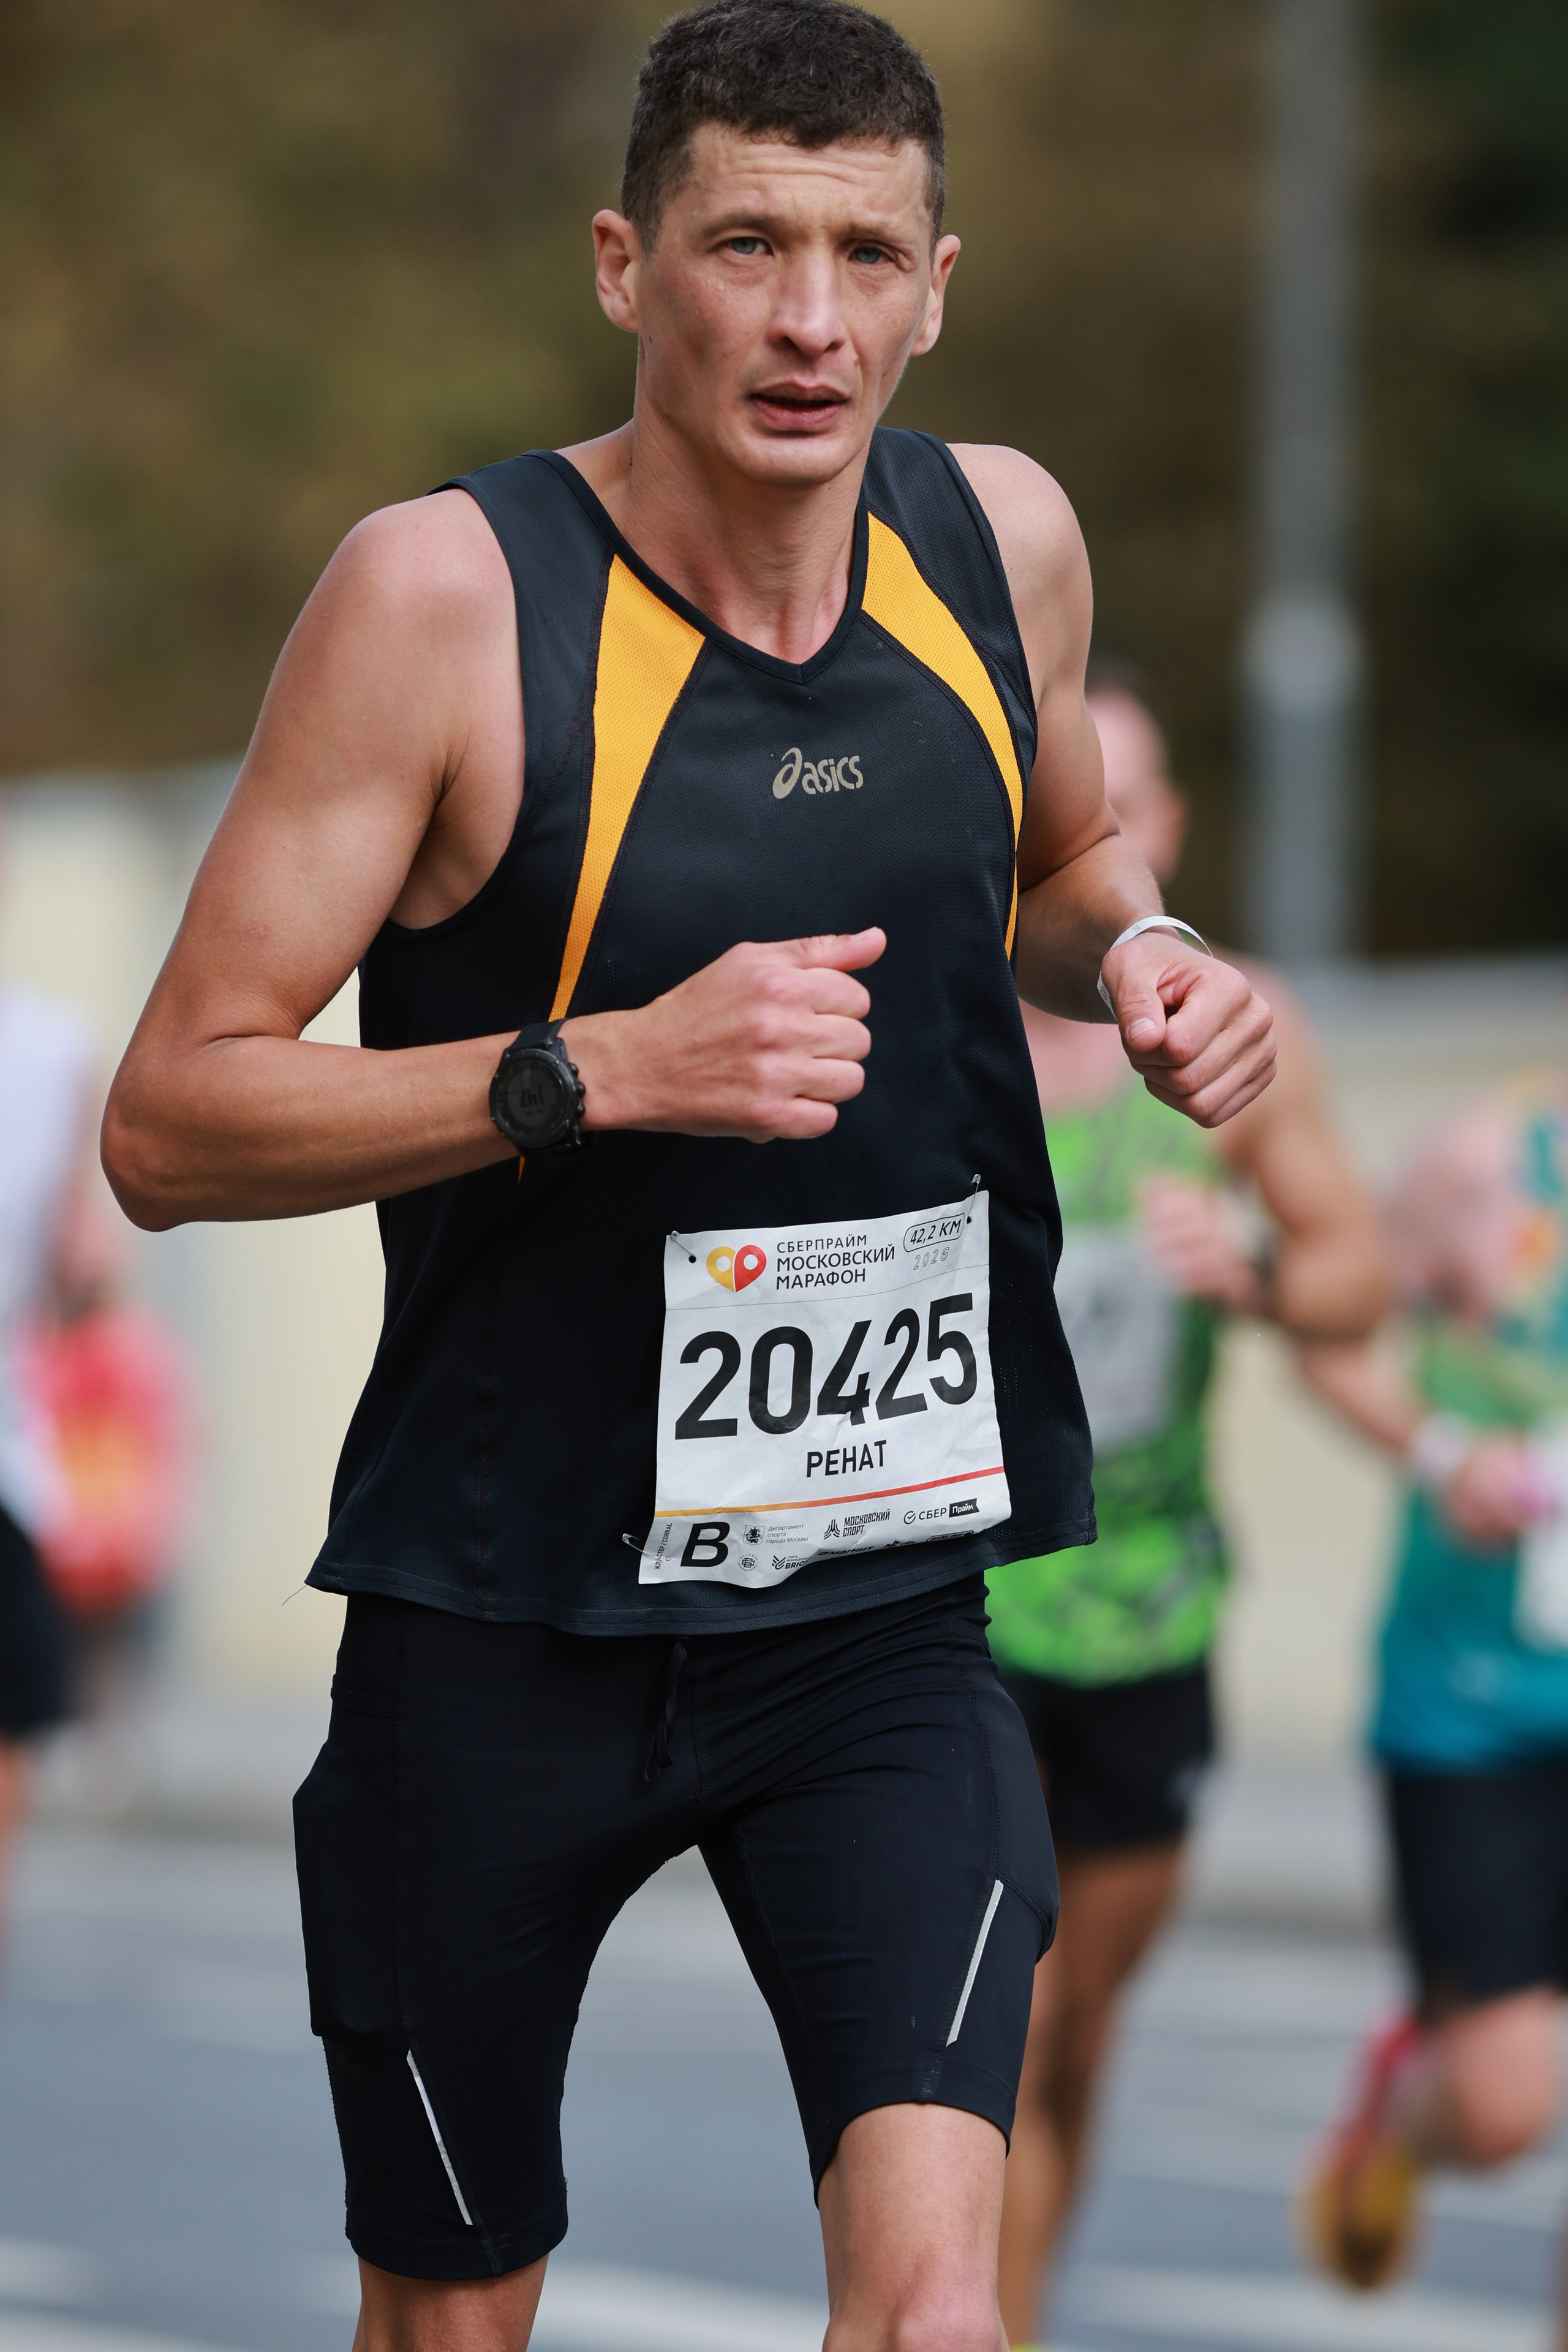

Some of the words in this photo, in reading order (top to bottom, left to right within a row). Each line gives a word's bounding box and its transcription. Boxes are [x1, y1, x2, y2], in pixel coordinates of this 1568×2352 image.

[777, 1234, 867, 1254] СБЕРПРАЙМ
[910, 1227, 937, 1245] 42,2
[777, 1244, 895, 1272] МОСКОВСКИЙ
[913, 1247, 949, 1270] 2026
[776, 1268, 865, 1290] МАРАФОН
[675, 1292, 978, 1441] 20425
[806, 1440, 887, 1478] РЕНАТ
[844, 1509, 890, 1526] МОСКОВСКИЙ
[919, 1507, 947, 1520] СБЕР
[952, 1504, 973, 1513] Прайм
[662, 1523, 673, 1542] CORRAL
[843, 1525, 865, 1537] СПОРТ
